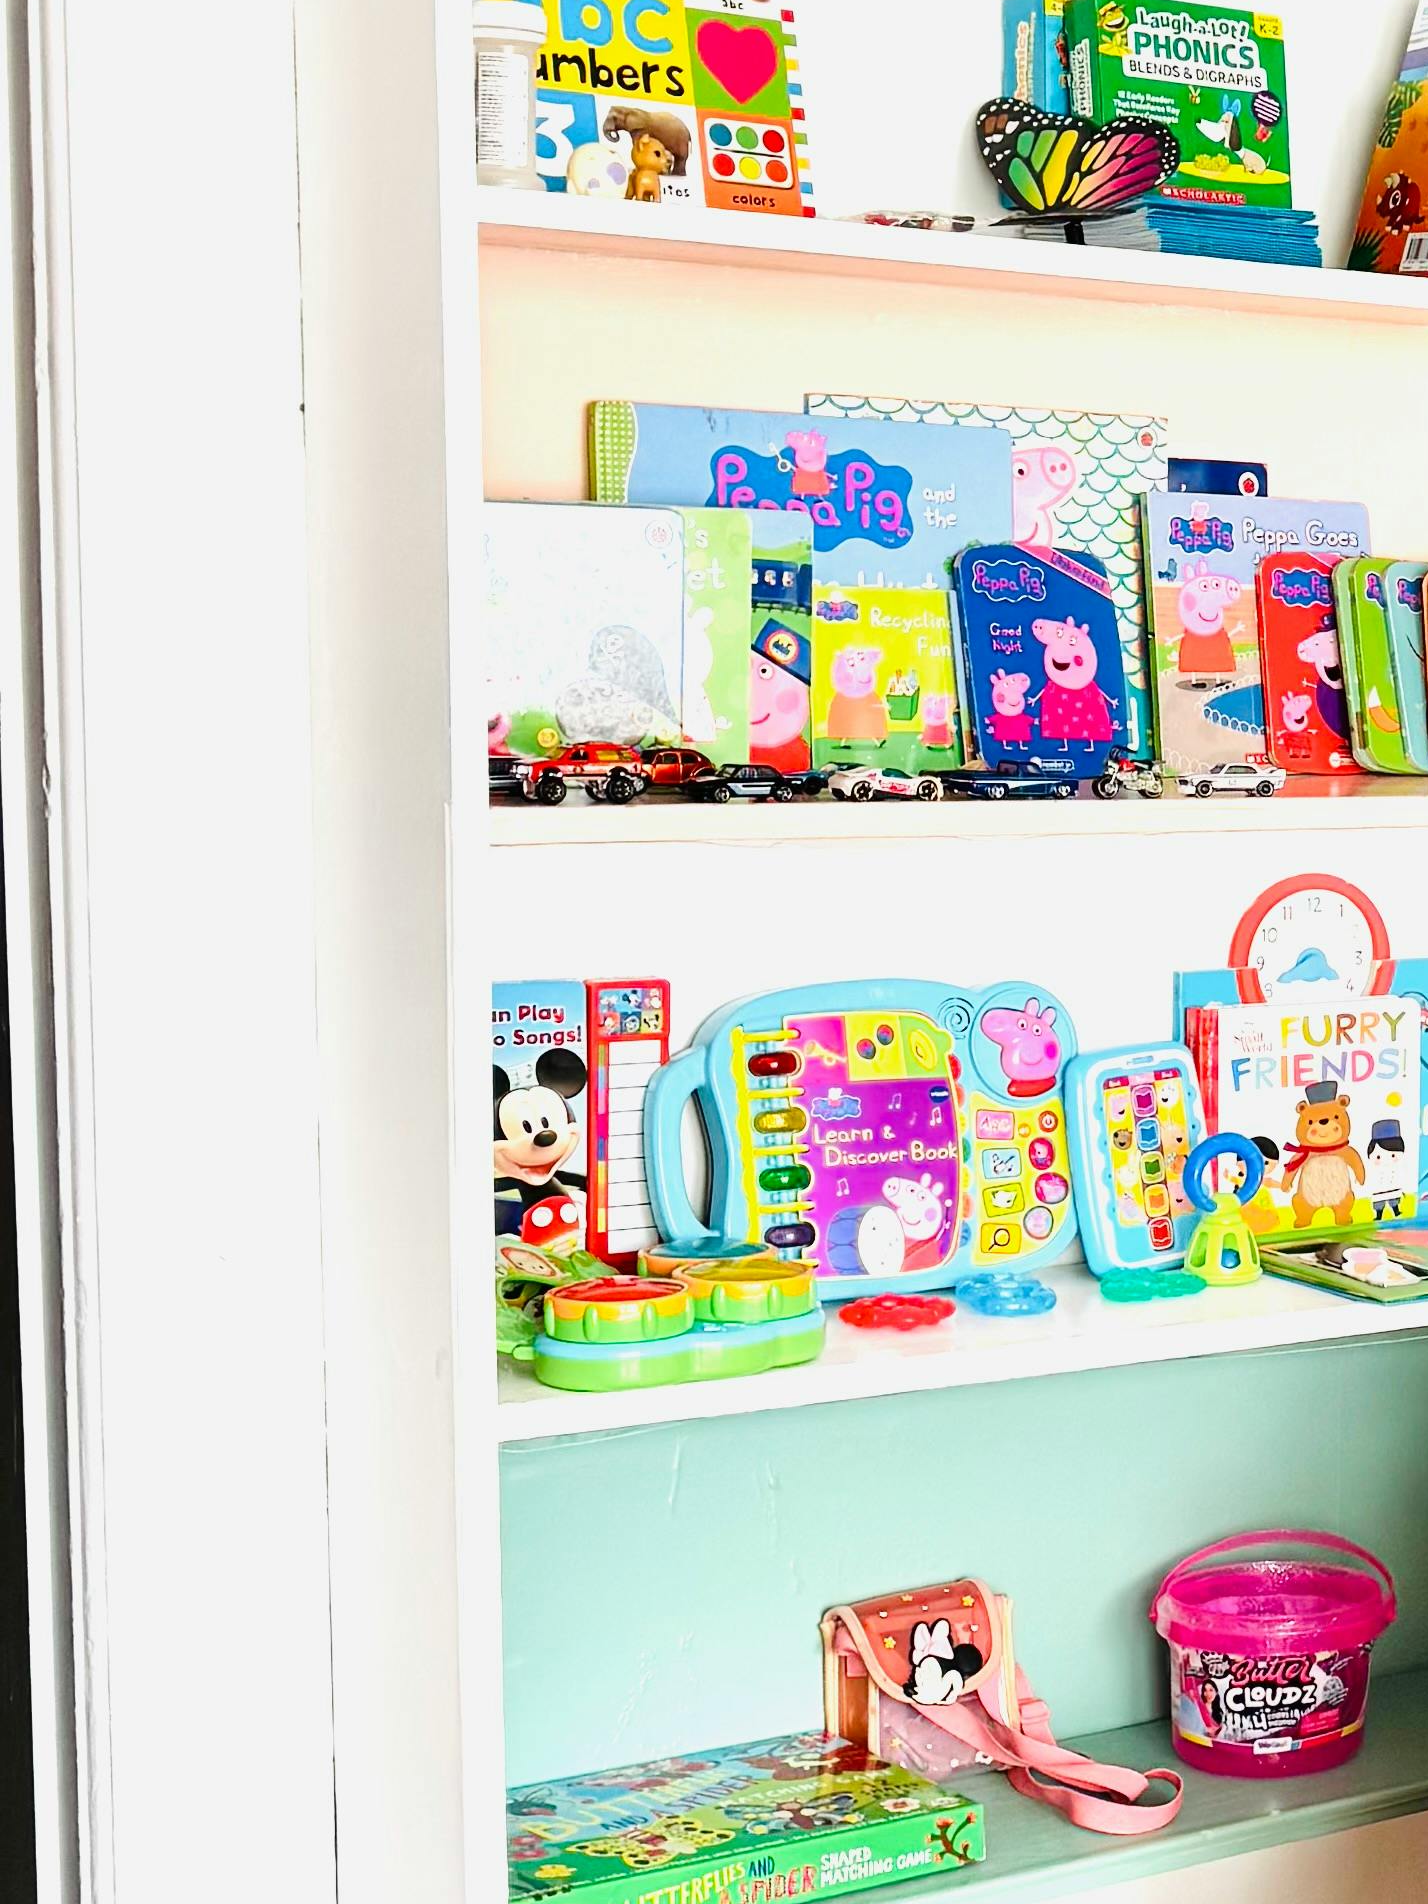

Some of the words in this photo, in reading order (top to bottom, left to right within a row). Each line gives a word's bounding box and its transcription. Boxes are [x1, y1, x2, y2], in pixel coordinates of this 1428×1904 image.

[1133, 31, 1255, 69] PHONICS
[1129, 59, 1180, 79] BLENDS
[1183, 67, 1193, 80] &
[1196, 68, 1263, 89] DIGRAPHS
[732, 193, 775, 208] colors
[845, 462, 912, 539] Pig
[923, 485, 956, 504] and
[924, 506, 958, 527] the
[1242, 517, 1299, 552] Peppa
[1305, 519, 1359, 547] Goes
[976, 564, 1019, 595] Peppa
[1020, 567, 1043, 597] Pig
[1274, 572, 1308, 600] Peppa
[870, 607, 950, 633] Recyclin
[918, 637, 952, 656] Fun
[1283, 905, 1292, 921] 11
[1307, 896, 1322, 913] 12
[1262, 927, 1278, 943] 10
[1257, 956, 1265, 971] 9
[1354, 950, 1363, 966] 3
[518, 1005, 565, 1024] Play
[513, 1025, 582, 1045] Songs!
[1280, 1010, 1406, 1049] FURRY
[1231, 1048, 1407, 1092] FRIENDS!
[814, 1124, 873, 1145] Learn
[883, 1125, 896, 1140] &
[825, 1146, 908, 1167] Discover
[911, 1140, 958, 1162] Book
[1226, 1685, 1316, 1711] CLOUDZ
[748, 1855, 776, 1876] AND
[820, 1845, 872, 1872] SHAPED
[820, 1853, 894, 1889] MATCHING
[897, 1847, 934, 1873] GAME
